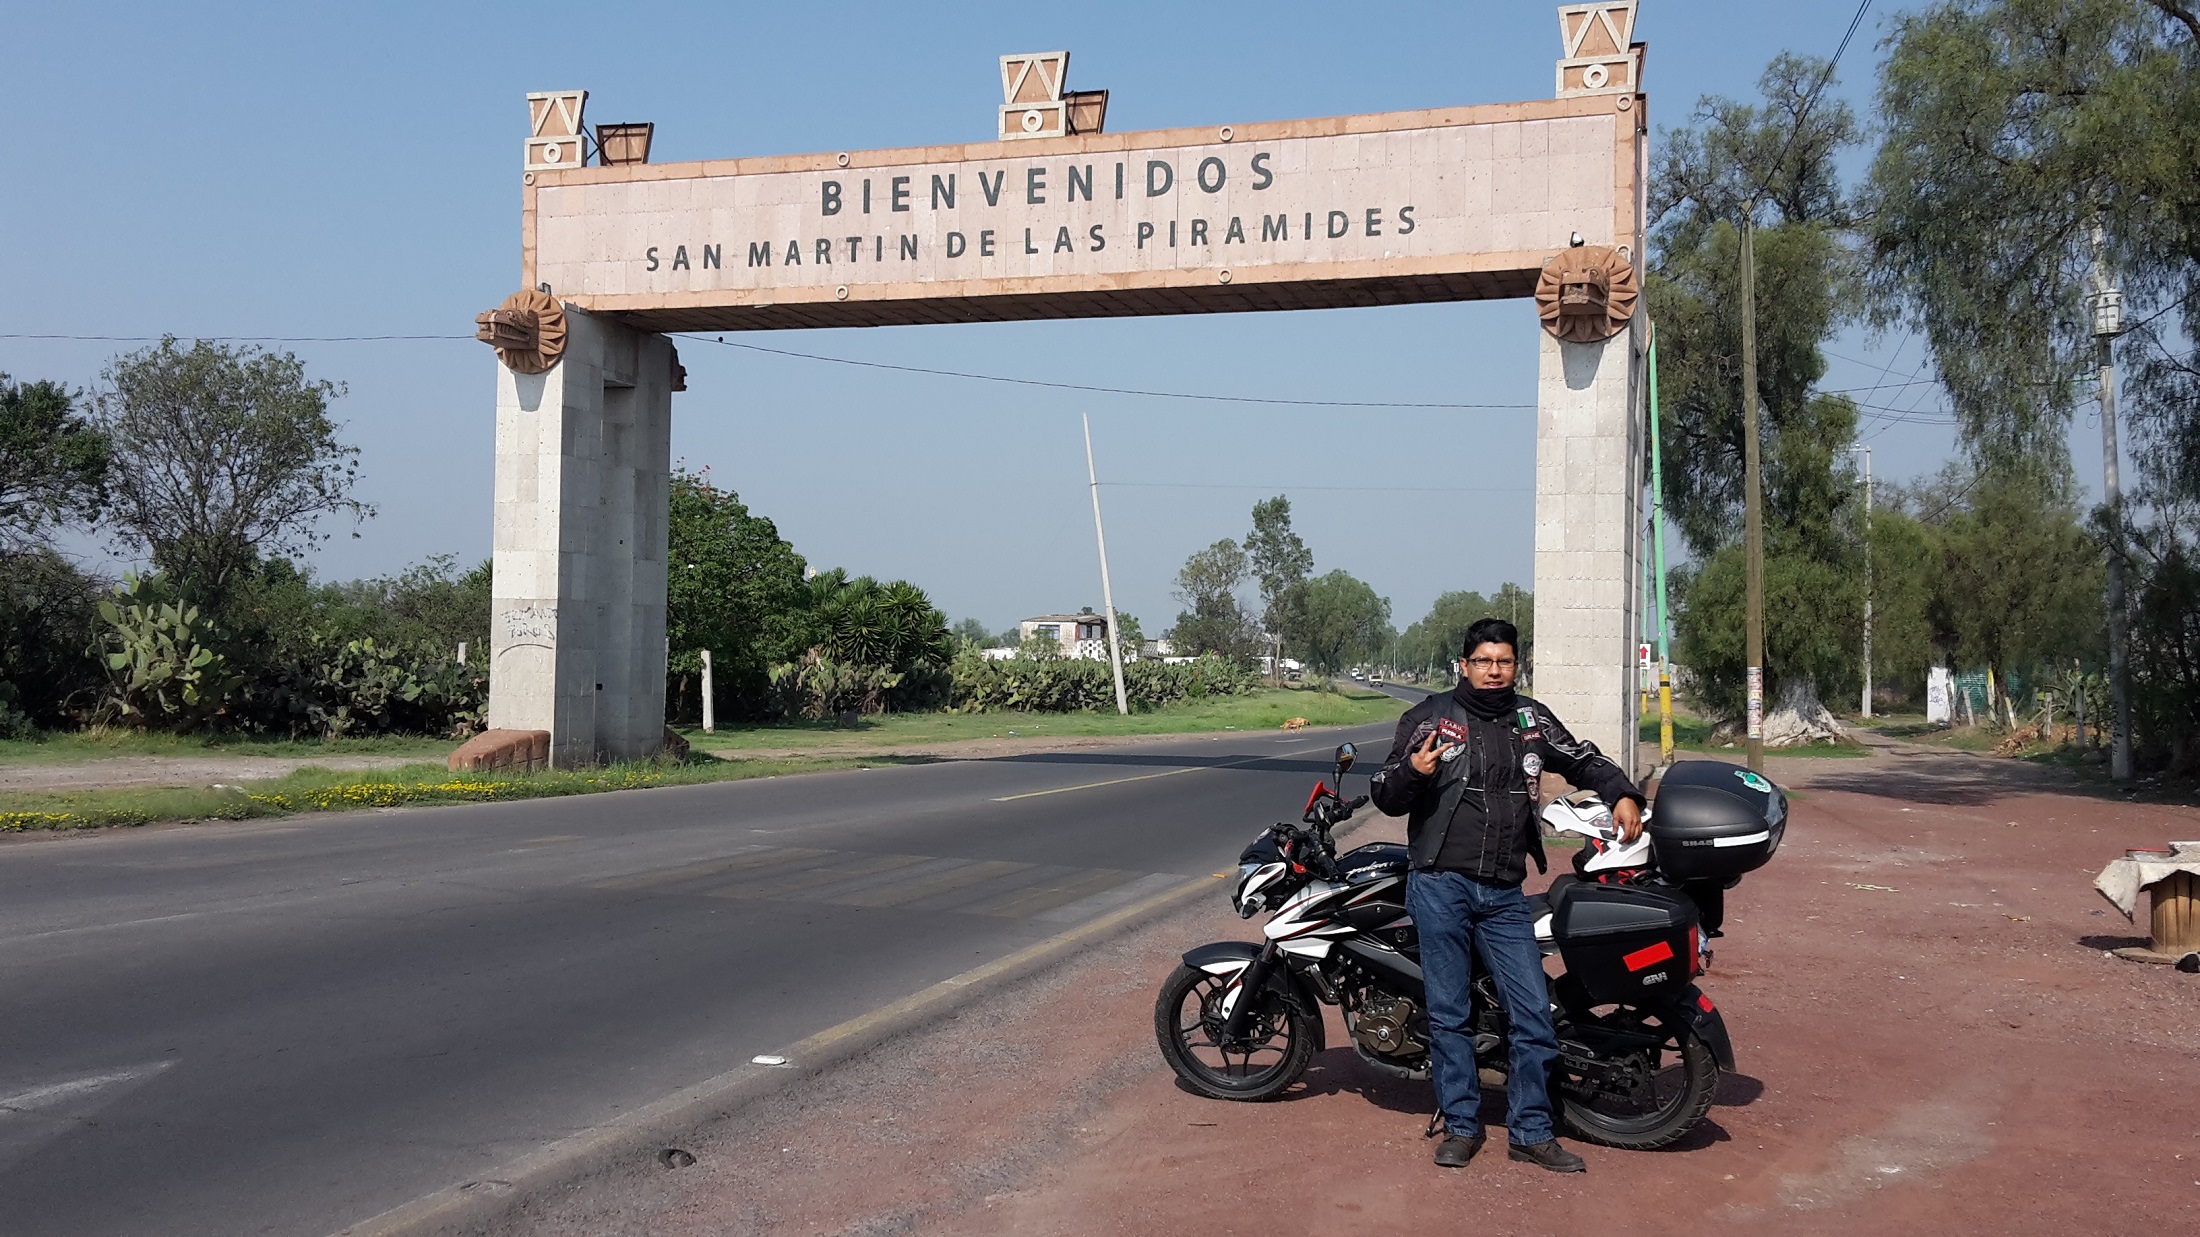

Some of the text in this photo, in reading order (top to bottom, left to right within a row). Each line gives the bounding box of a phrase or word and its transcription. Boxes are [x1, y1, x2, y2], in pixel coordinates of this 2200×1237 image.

[821, 152, 1273, 217] BIENVENIDOS
[646, 206, 1415, 272] SAN MARTIN DE LAS PIRAMIDES
[1642, 971, 1668, 986] GIVI
